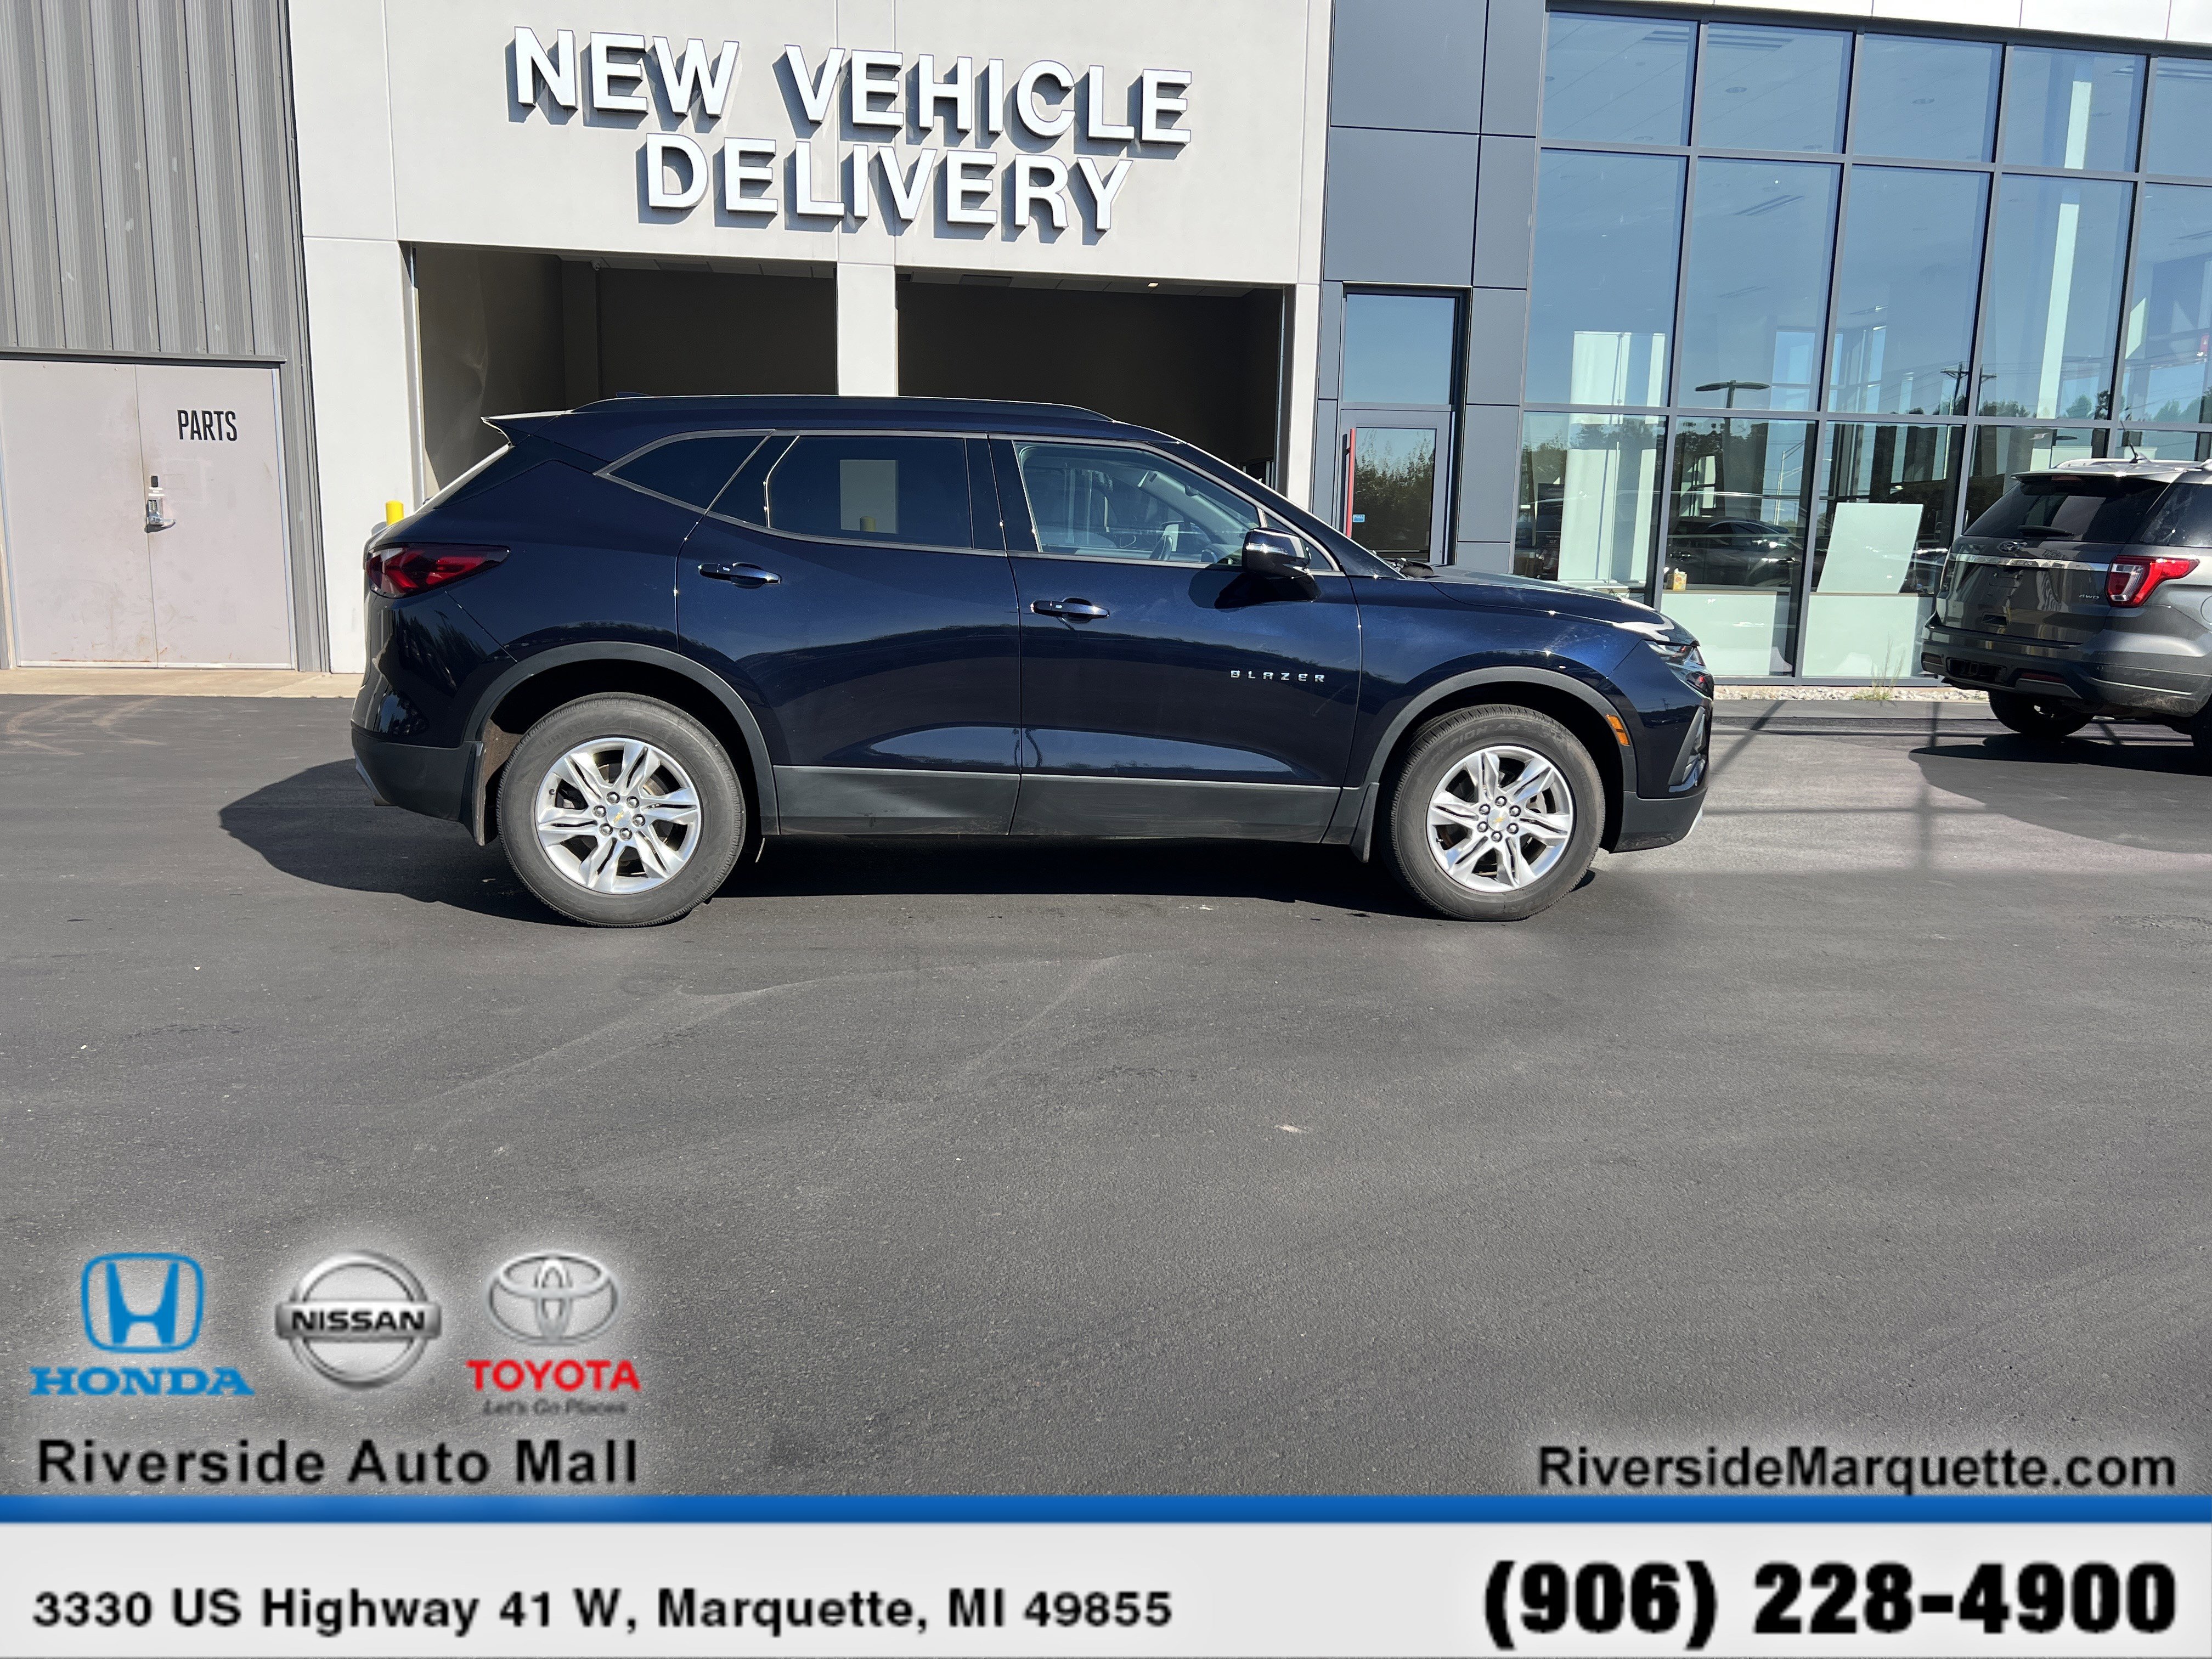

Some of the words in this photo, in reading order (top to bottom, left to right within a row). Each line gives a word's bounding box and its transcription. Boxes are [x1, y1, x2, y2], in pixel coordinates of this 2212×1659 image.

[514, 26, 740, 117] NEW
[785, 44, 1192, 144] VEHICLE
[646, 133, 1133, 231] DELIVERY
[177, 410, 238, 441] PARTS
[1231, 670, 1324, 682] BLAZER
